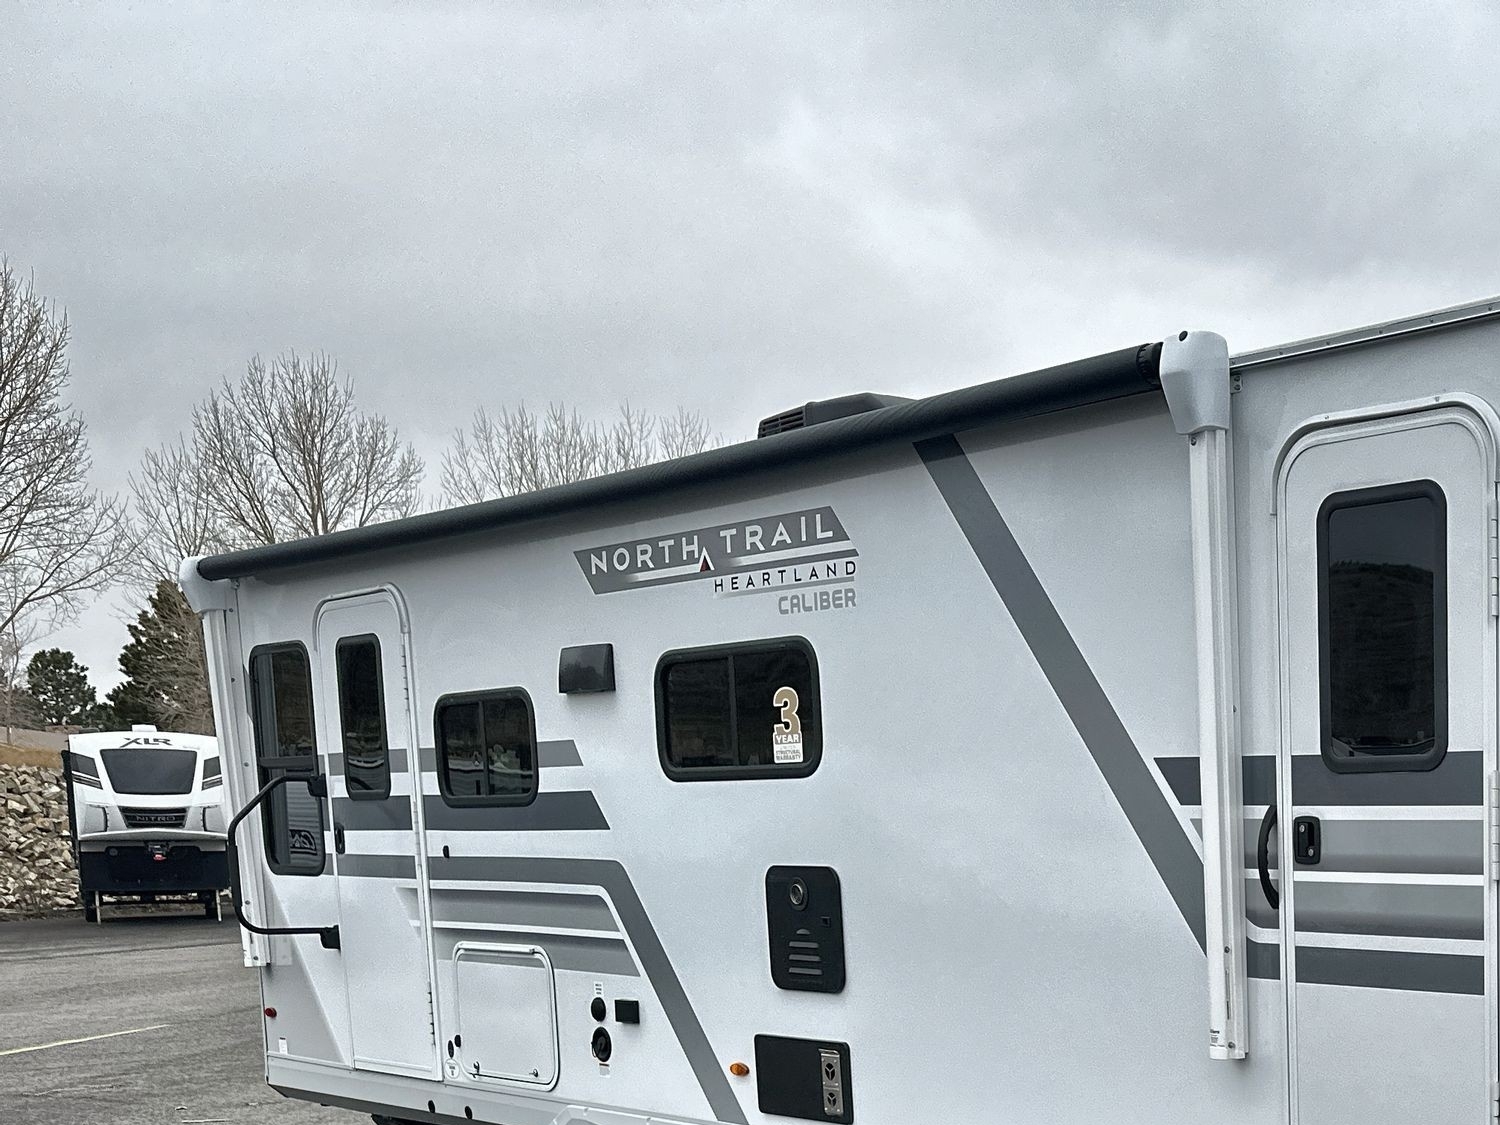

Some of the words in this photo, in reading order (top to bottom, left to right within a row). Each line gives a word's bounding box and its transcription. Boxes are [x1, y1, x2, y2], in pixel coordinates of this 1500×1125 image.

[590, 534, 700, 575] NORTH
[719, 513, 834, 553] TRAIL
[713, 561, 857, 593] HEARTLAND
[778, 588, 857, 615] CALIBER
[773, 686, 801, 735] 3
[119, 737, 173, 749] XLR
[775, 733, 800, 744] YEAR
